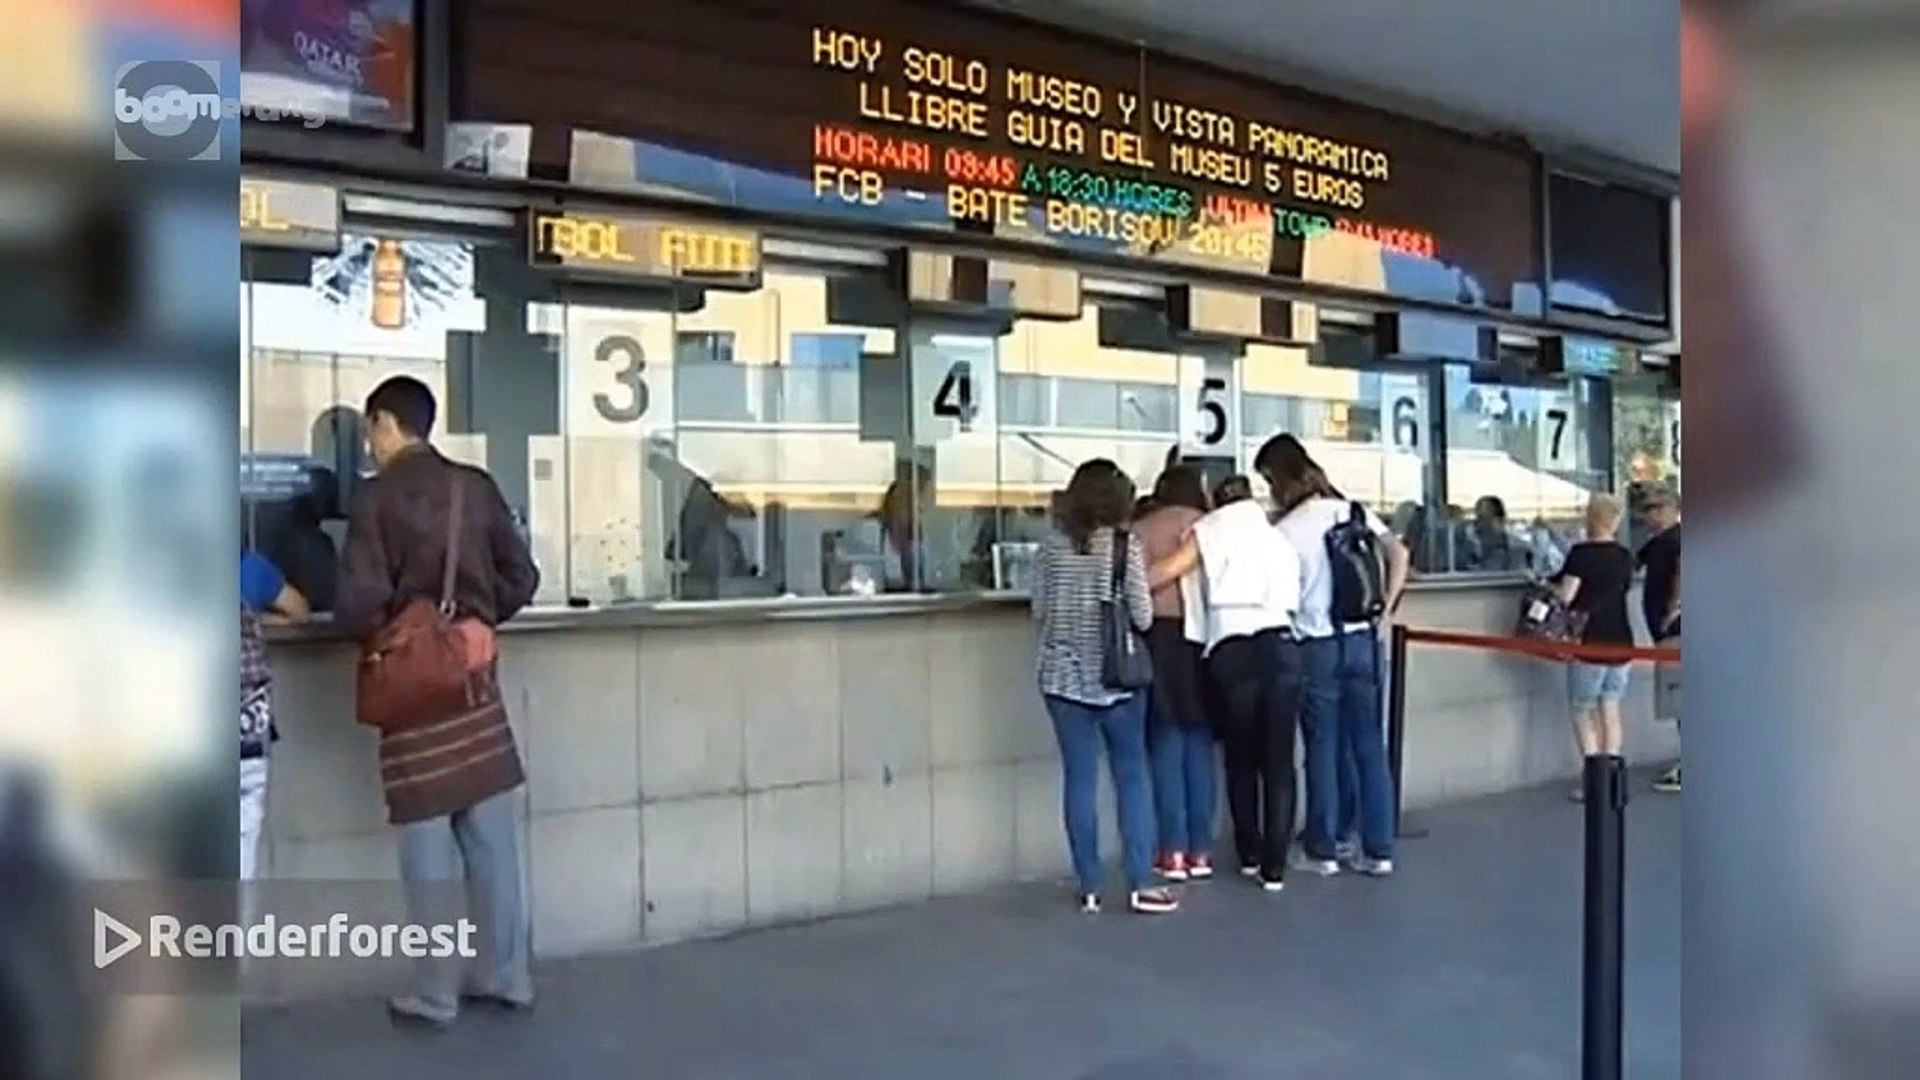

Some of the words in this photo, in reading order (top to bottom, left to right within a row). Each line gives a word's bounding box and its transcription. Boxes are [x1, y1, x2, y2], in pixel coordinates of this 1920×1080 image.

[294, 31, 362, 80] QATAR
[812, 28, 881, 73] HOY
[903, 47, 987, 95] SOLO
[1006, 68, 1101, 118] MUSEO
[1117, 91, 1136, 125] Y
[1152, 99, 1235, 148] VISTA
[1248, 121, 1389, 181] PANORAMICA
[814, 125, 930, 173] HORARI
[1021, 162, 1043, 192] A
[860, 81, 989, 137] LLIBRE
[1007, 110, 1085, 155] GUIA
[1100, 127, 1155, 169] DEL
[1169, 141, 1251, 187] MUSEU
[1264, 162, 1281, 193] 5
[1292, 167, 1364, 209] EUROS
[814, 163, 884, 207] FCB
[947, 183, 1028, 227] BATE
[592, 335, 649, 423] 3
[932, 359, 978, 433] 4
[1196, 379, 1227, 445] 5
[1393, 396, 1419, 453] 6
[1545, 408, 1568, 460] 7
